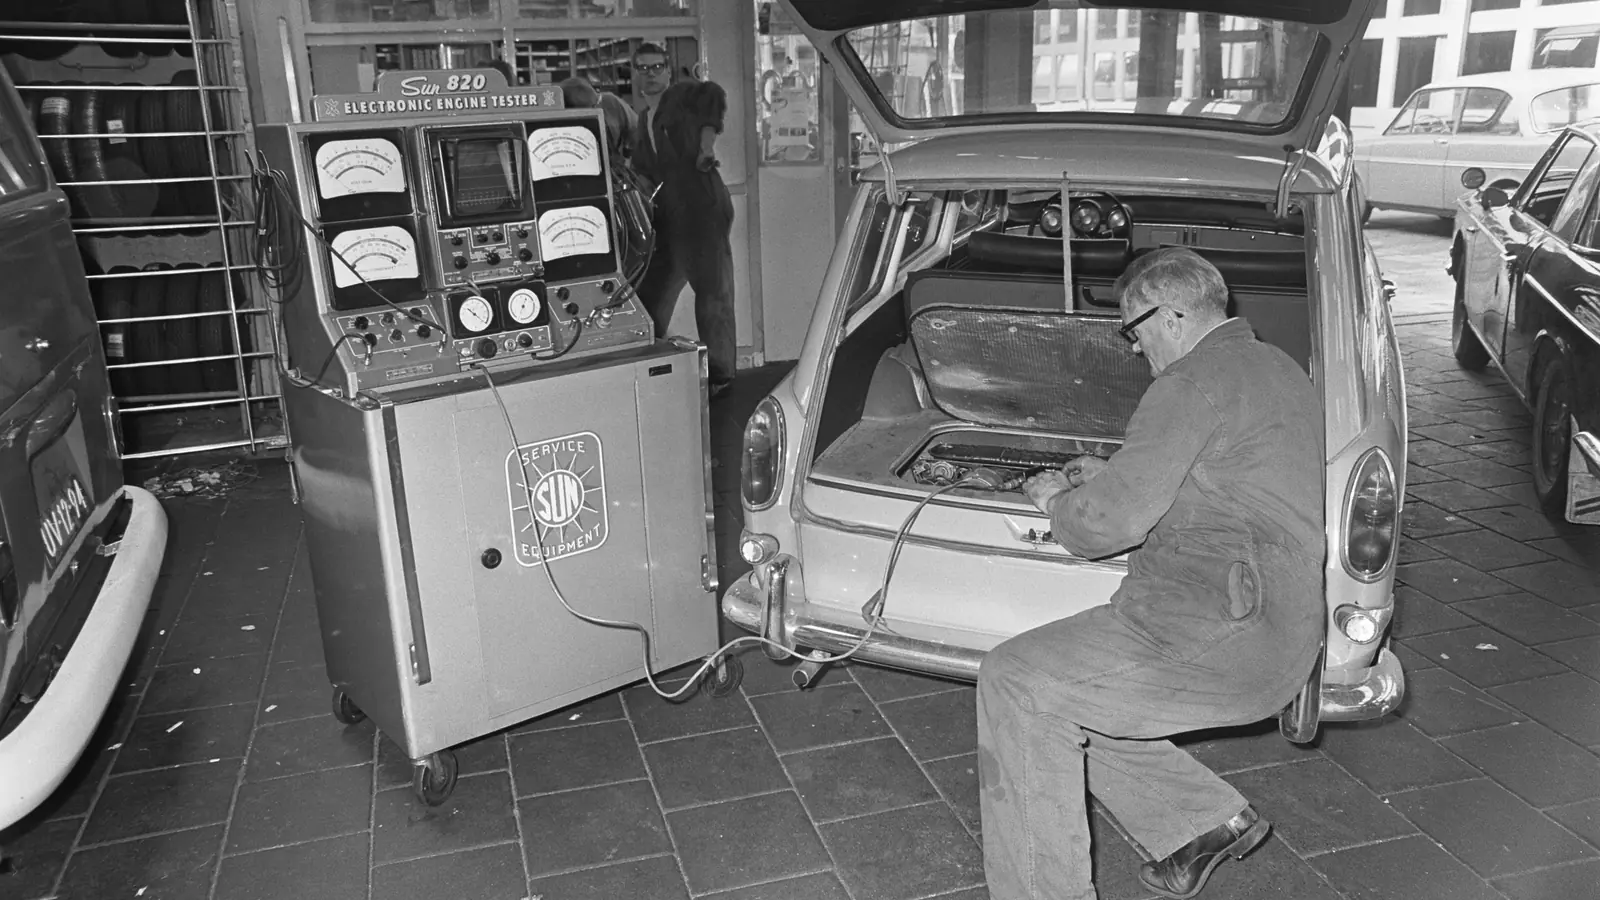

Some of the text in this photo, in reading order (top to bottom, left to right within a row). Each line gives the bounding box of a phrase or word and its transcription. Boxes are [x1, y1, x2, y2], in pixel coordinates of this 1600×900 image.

[401, 74, 486, 96] Sun 820
[344, 94, 538, 114] ELECTRONIC ENGINE TESTER
[521, 441, 585, 466] SERVICE
[536, 474, 579, 523] SUN
[521, 523, 600, 558] EQUIPMENT
